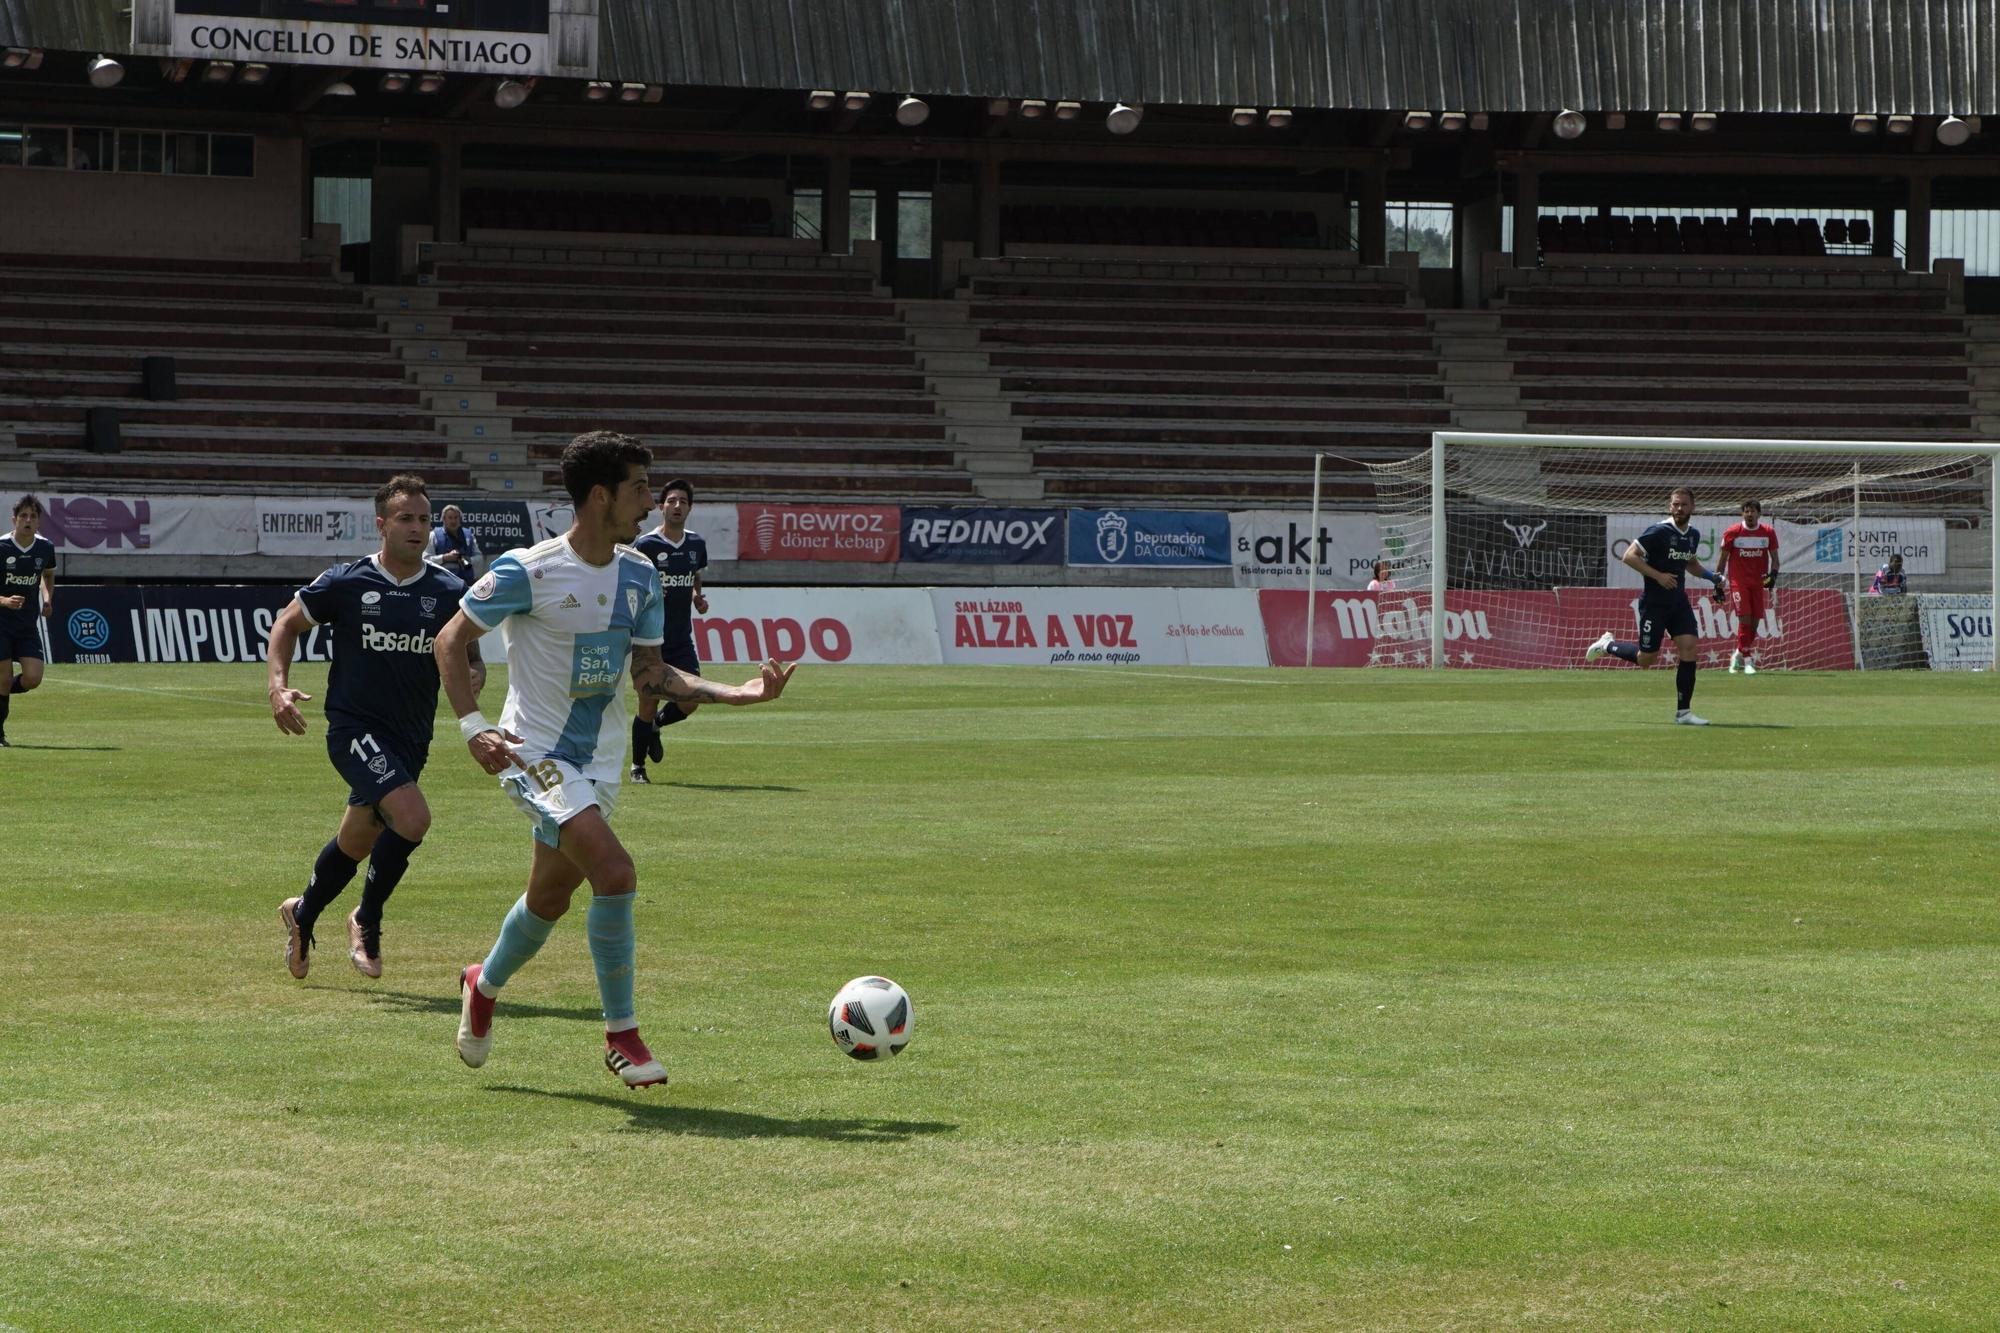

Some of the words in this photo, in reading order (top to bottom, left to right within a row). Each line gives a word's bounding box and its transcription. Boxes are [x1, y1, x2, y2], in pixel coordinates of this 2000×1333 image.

[191, 26, 335, 55] CONCELLO
[349, 35, 382, 57] DE
[395, 37, 532, 65] SANTIAGO
[262, 513, 323, 533] ENTRENA
[461, 511, 520, 523] EDERACIÓN
[782, 512, 884, 532] newroz
[485, 524, 525, 538] FÚTBOL
[908, 516, 1056, 549] REDINOX
[1134, 531, 1205, 546] Deputación
[780, 532, 830, 548] döner
[835, 533, 886, 553] kebap
[1134, 545, 1151, 557] DA
[1154, 543, 1206, 557] CORUÑA
[1238, 536, 1250, 552] &
[1254, 522, 1333, 565] akt
[1305, 566, 1333, 576] slud
[1732, 591, 1741, 602] 13
[954, 601, 978, 613] SAN
[980, 599, 1023, 613] LÁZARO
[955, 614, 1038, 648] ALZA
[1047, 614, 1070, 648] A
[1073, 614, 1138, 648] VOZ
[1643, 620, 1652, 633] 5
[361, 623, 436, 654] Posada
[580, 656, 610, 670] San
[1078, 651, 1103, 662] noso
[1106, 650, 1141, 664] equipo
[349, 733, 381, 762] 11
